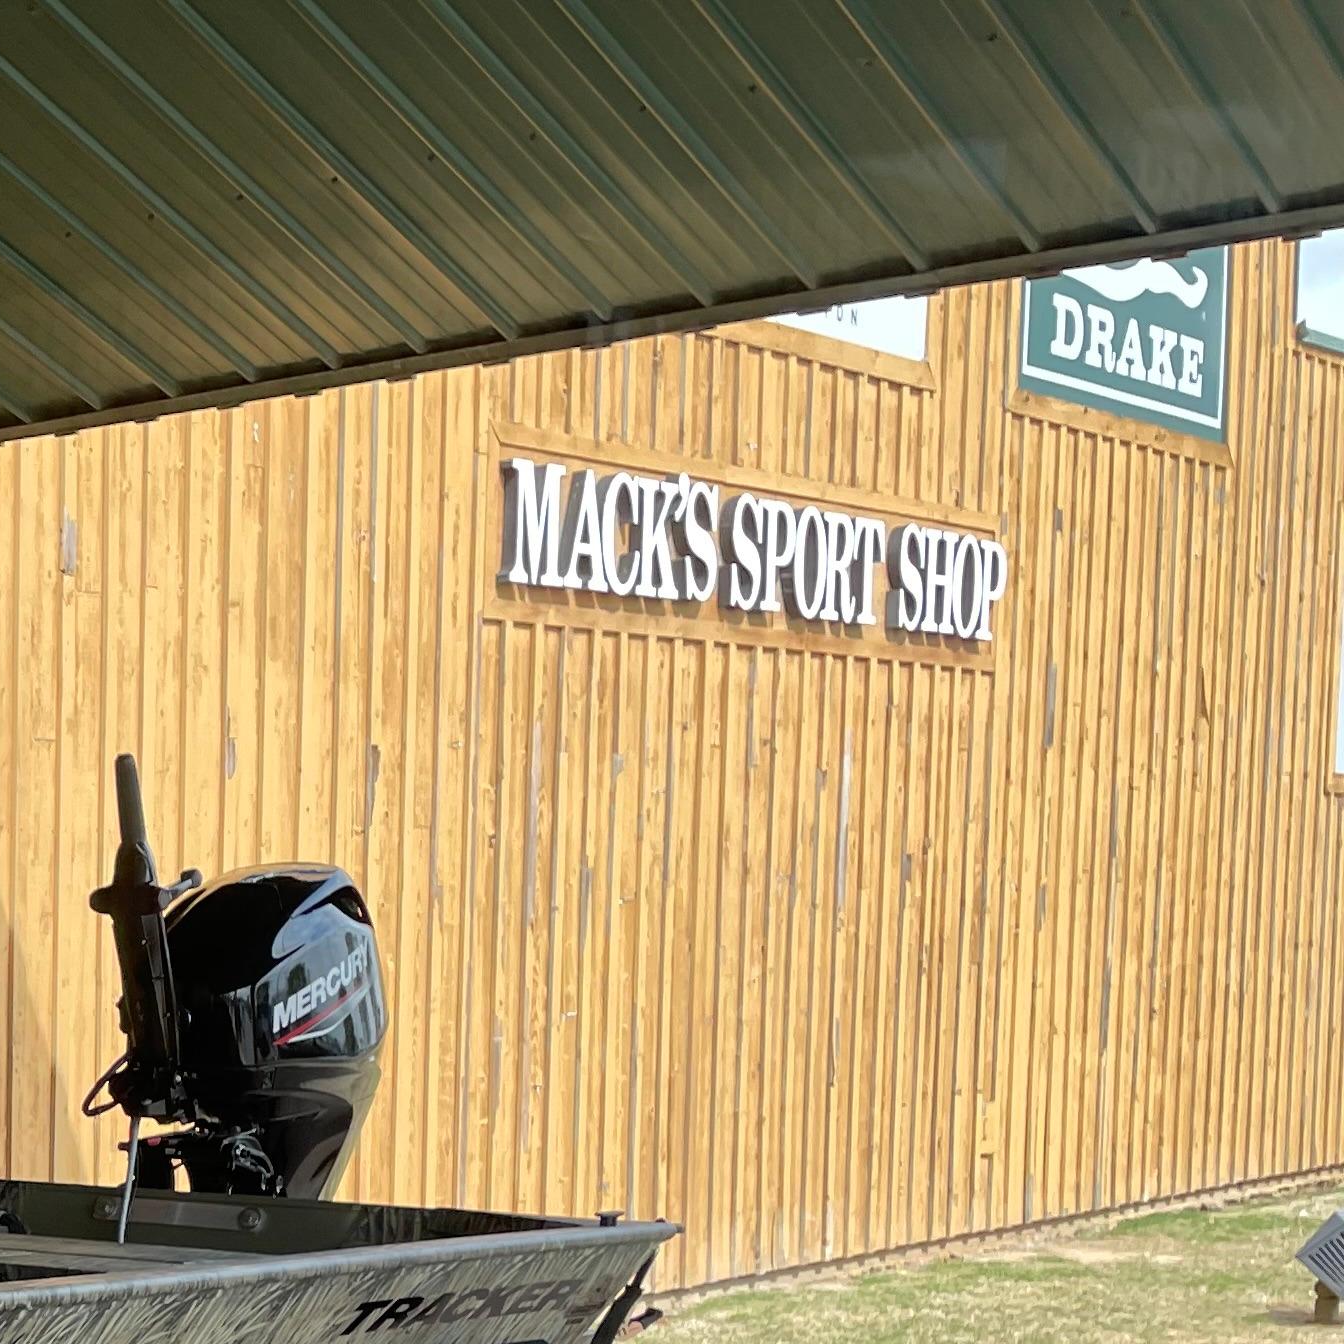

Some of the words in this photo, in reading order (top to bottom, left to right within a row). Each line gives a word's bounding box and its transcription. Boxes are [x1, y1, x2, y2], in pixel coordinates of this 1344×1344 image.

[1050, 292, 1204, 398] DRAKE
[507, 458, 719, 601] MACK'S
[729, 493, 886, 625] SPORT
[897, 522, 1008, 642] SHOP
[272, 938, 369, 1034] MERCURY
[340, 1279, 583, 1335] TRACKER
